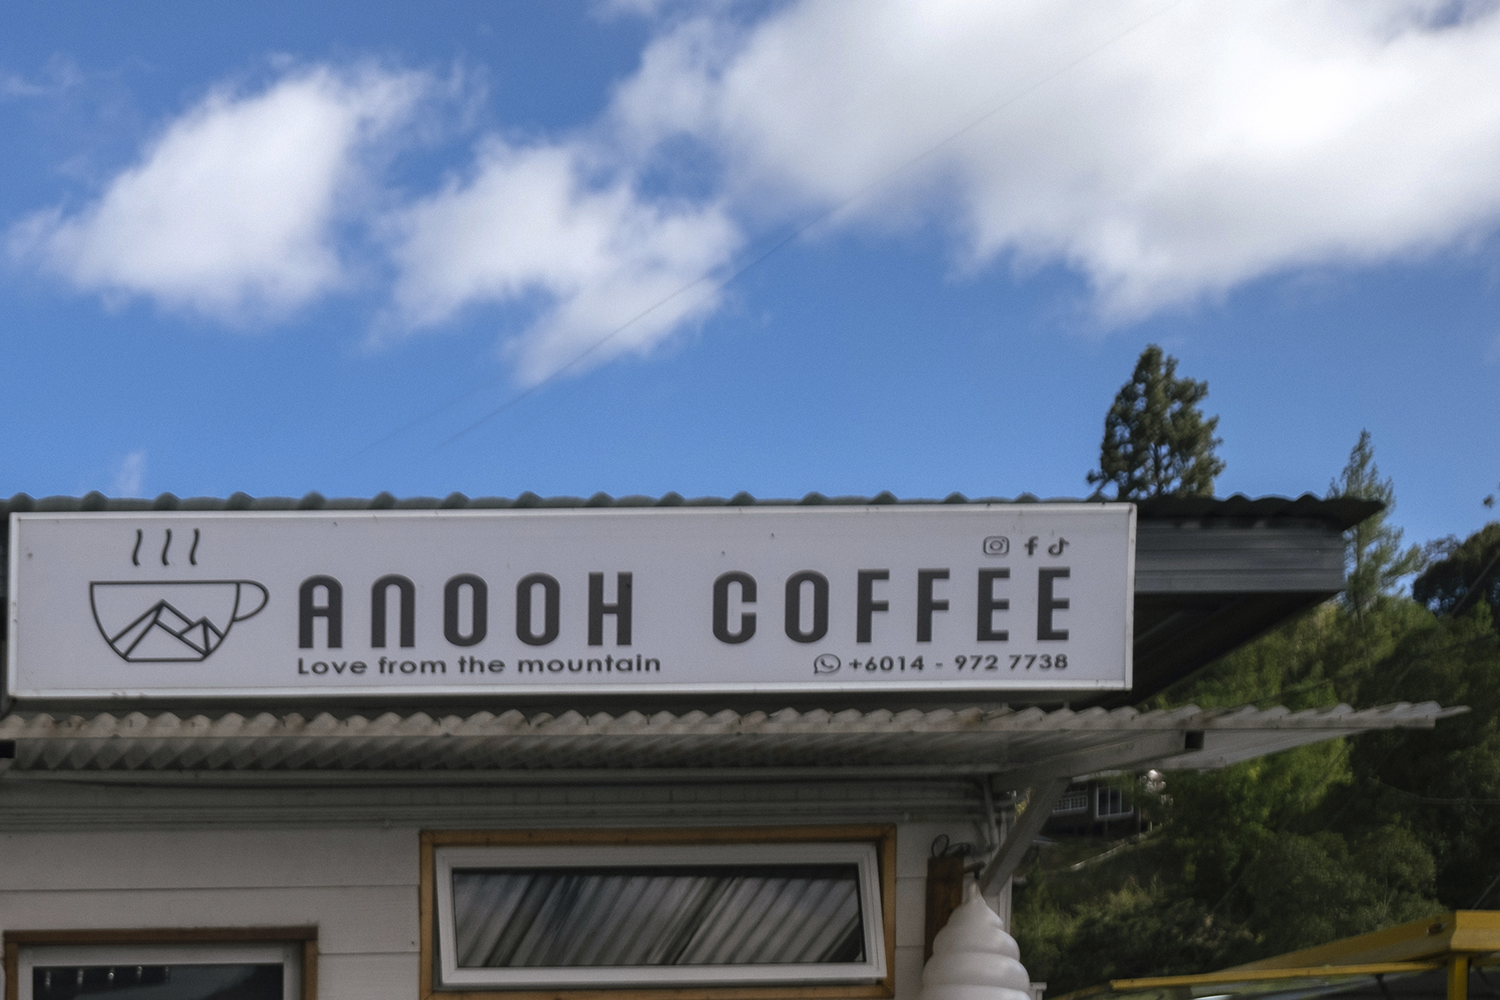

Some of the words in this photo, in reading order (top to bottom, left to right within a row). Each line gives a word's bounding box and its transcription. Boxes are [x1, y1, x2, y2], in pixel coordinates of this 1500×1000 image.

[298, 571, 633, 649] ANOOH
[712, 566, 1071, 644] COFFEE
[298, 657, 368, 676] Love
[379, 656, 447, 676] from
[458, 655, 506, 675] the
[518, 653, 661, 674] mountain
[848, 655, 924, 671] +6014
[954, 654, 999, 671] 972
[1009, 653, 1069, 671] 7738
